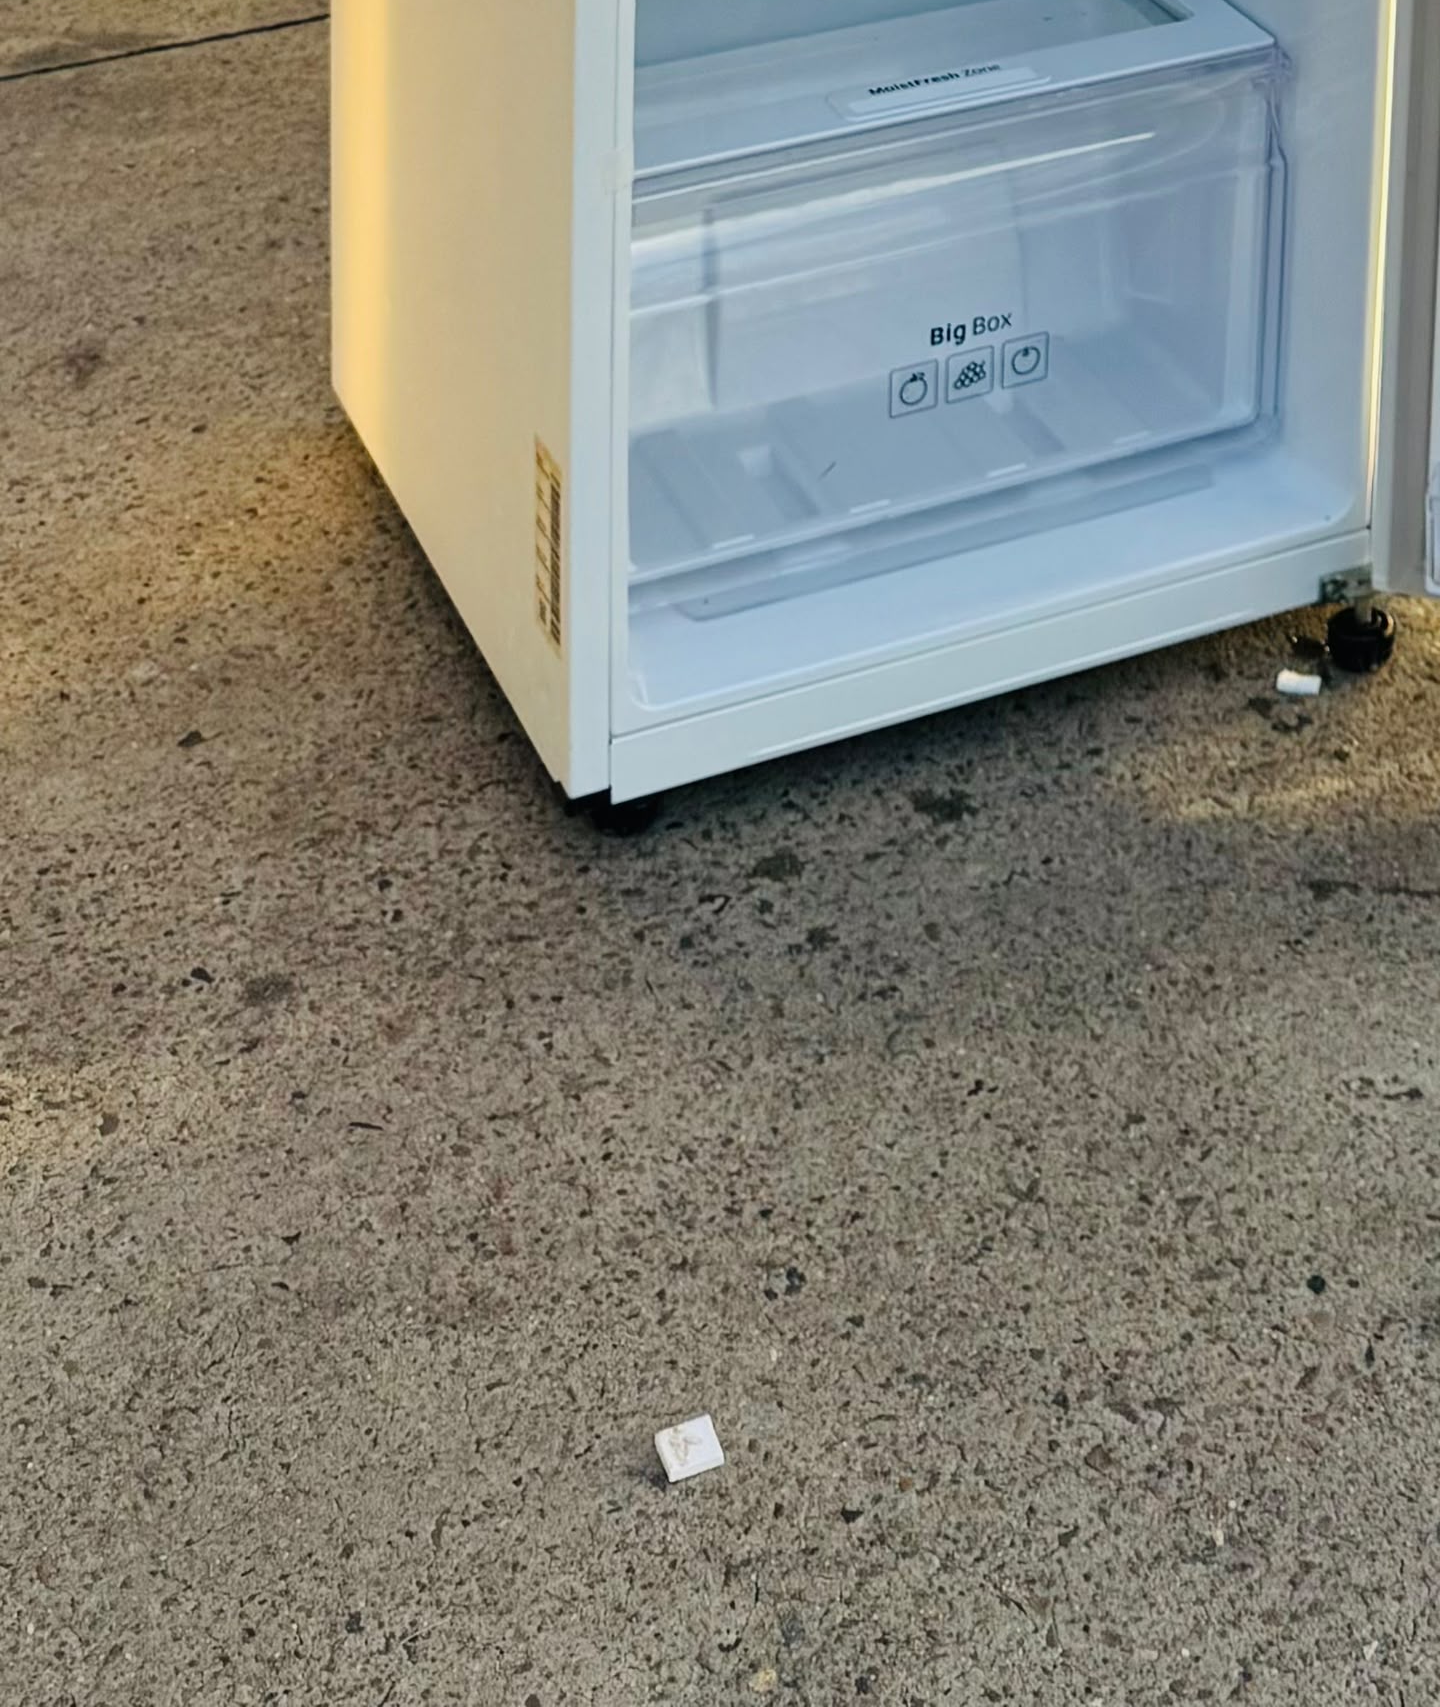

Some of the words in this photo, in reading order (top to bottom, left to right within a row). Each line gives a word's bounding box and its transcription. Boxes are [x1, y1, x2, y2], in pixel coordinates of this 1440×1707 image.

[963, 64, 1001, 77] Zone
[930, 322, 966, 346] Big
[972, 312, 1013, 336] Box
